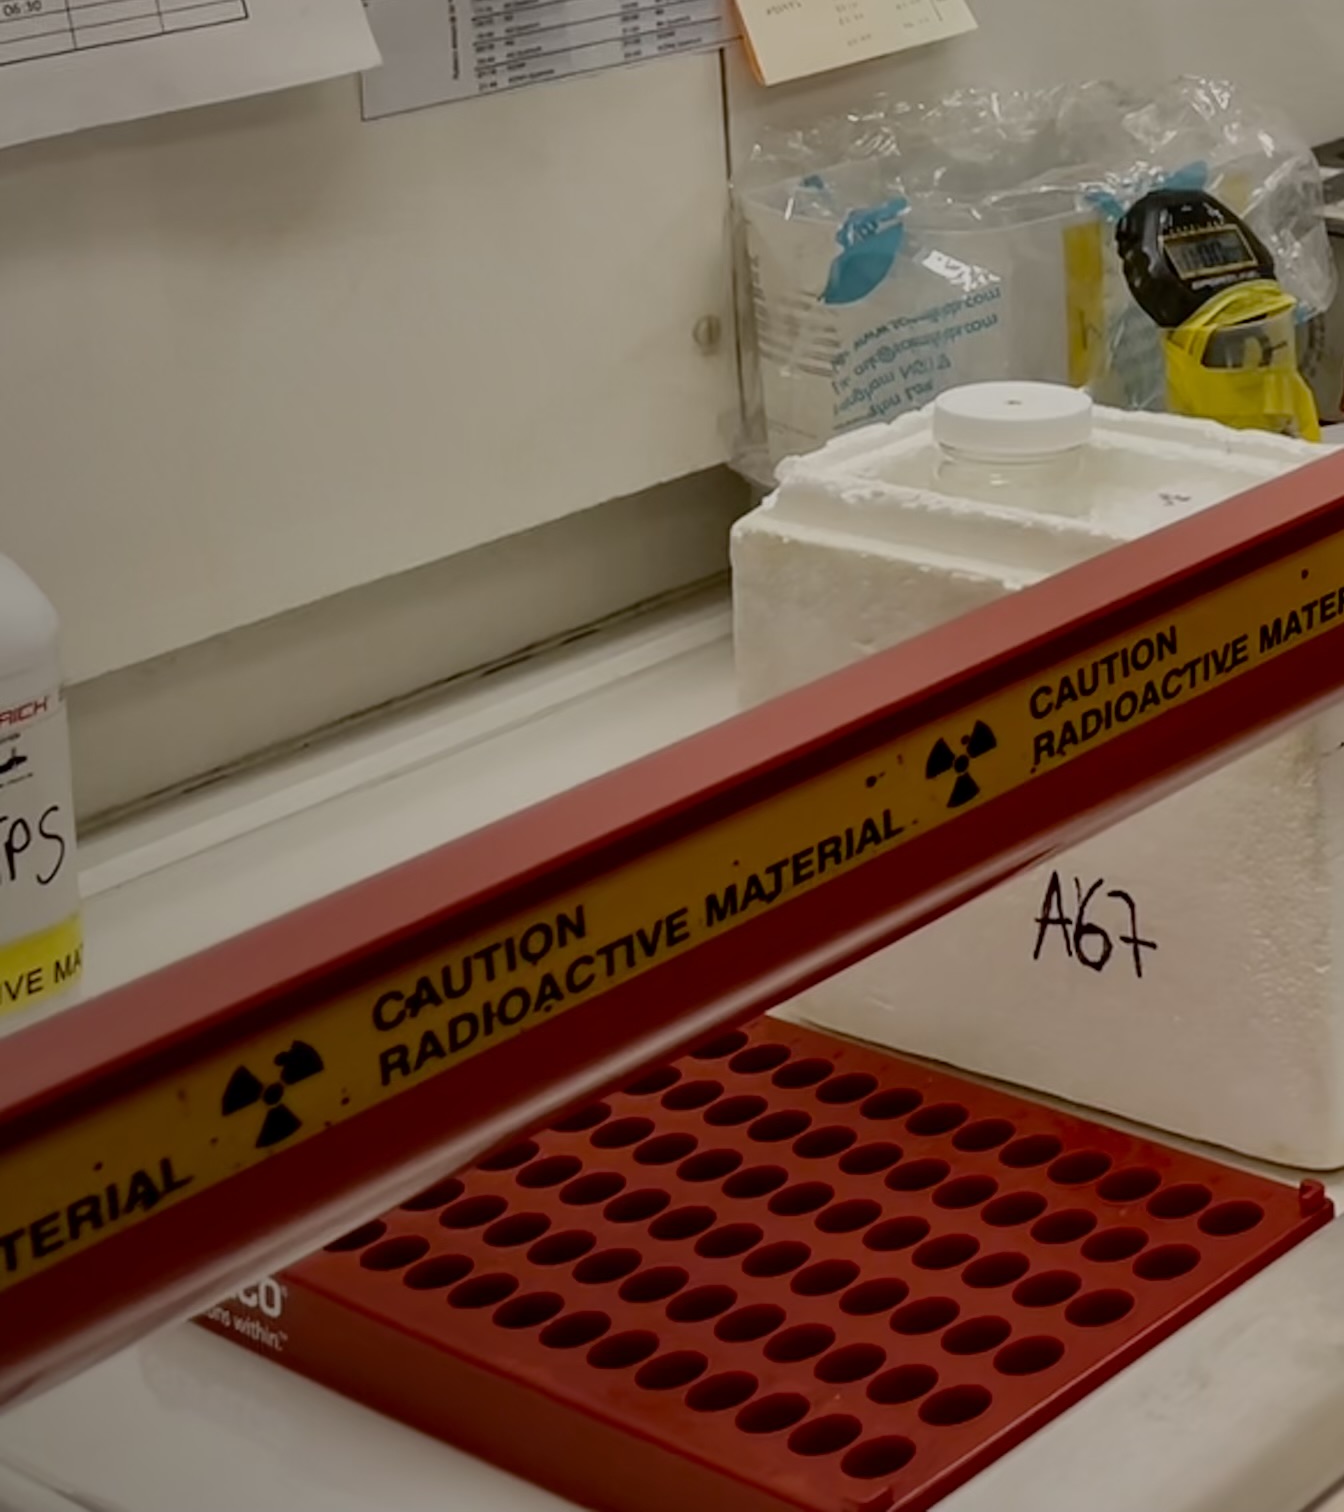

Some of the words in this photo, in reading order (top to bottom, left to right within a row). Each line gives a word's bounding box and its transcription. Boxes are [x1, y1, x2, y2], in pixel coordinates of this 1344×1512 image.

[1029, 625, 1179, 720] CAUTION
[1033, 634, 1250, 767] RADIOACTIVE
[371, 903, 587, 1033] CAUTION
[378, 907, 692, 1087] RADIOACTIVE
[705, 807, 905, 928] MATERIAL
[1032, 867, 1158, 978] A67
[0, 1157, 194, 1276] TERIAL
